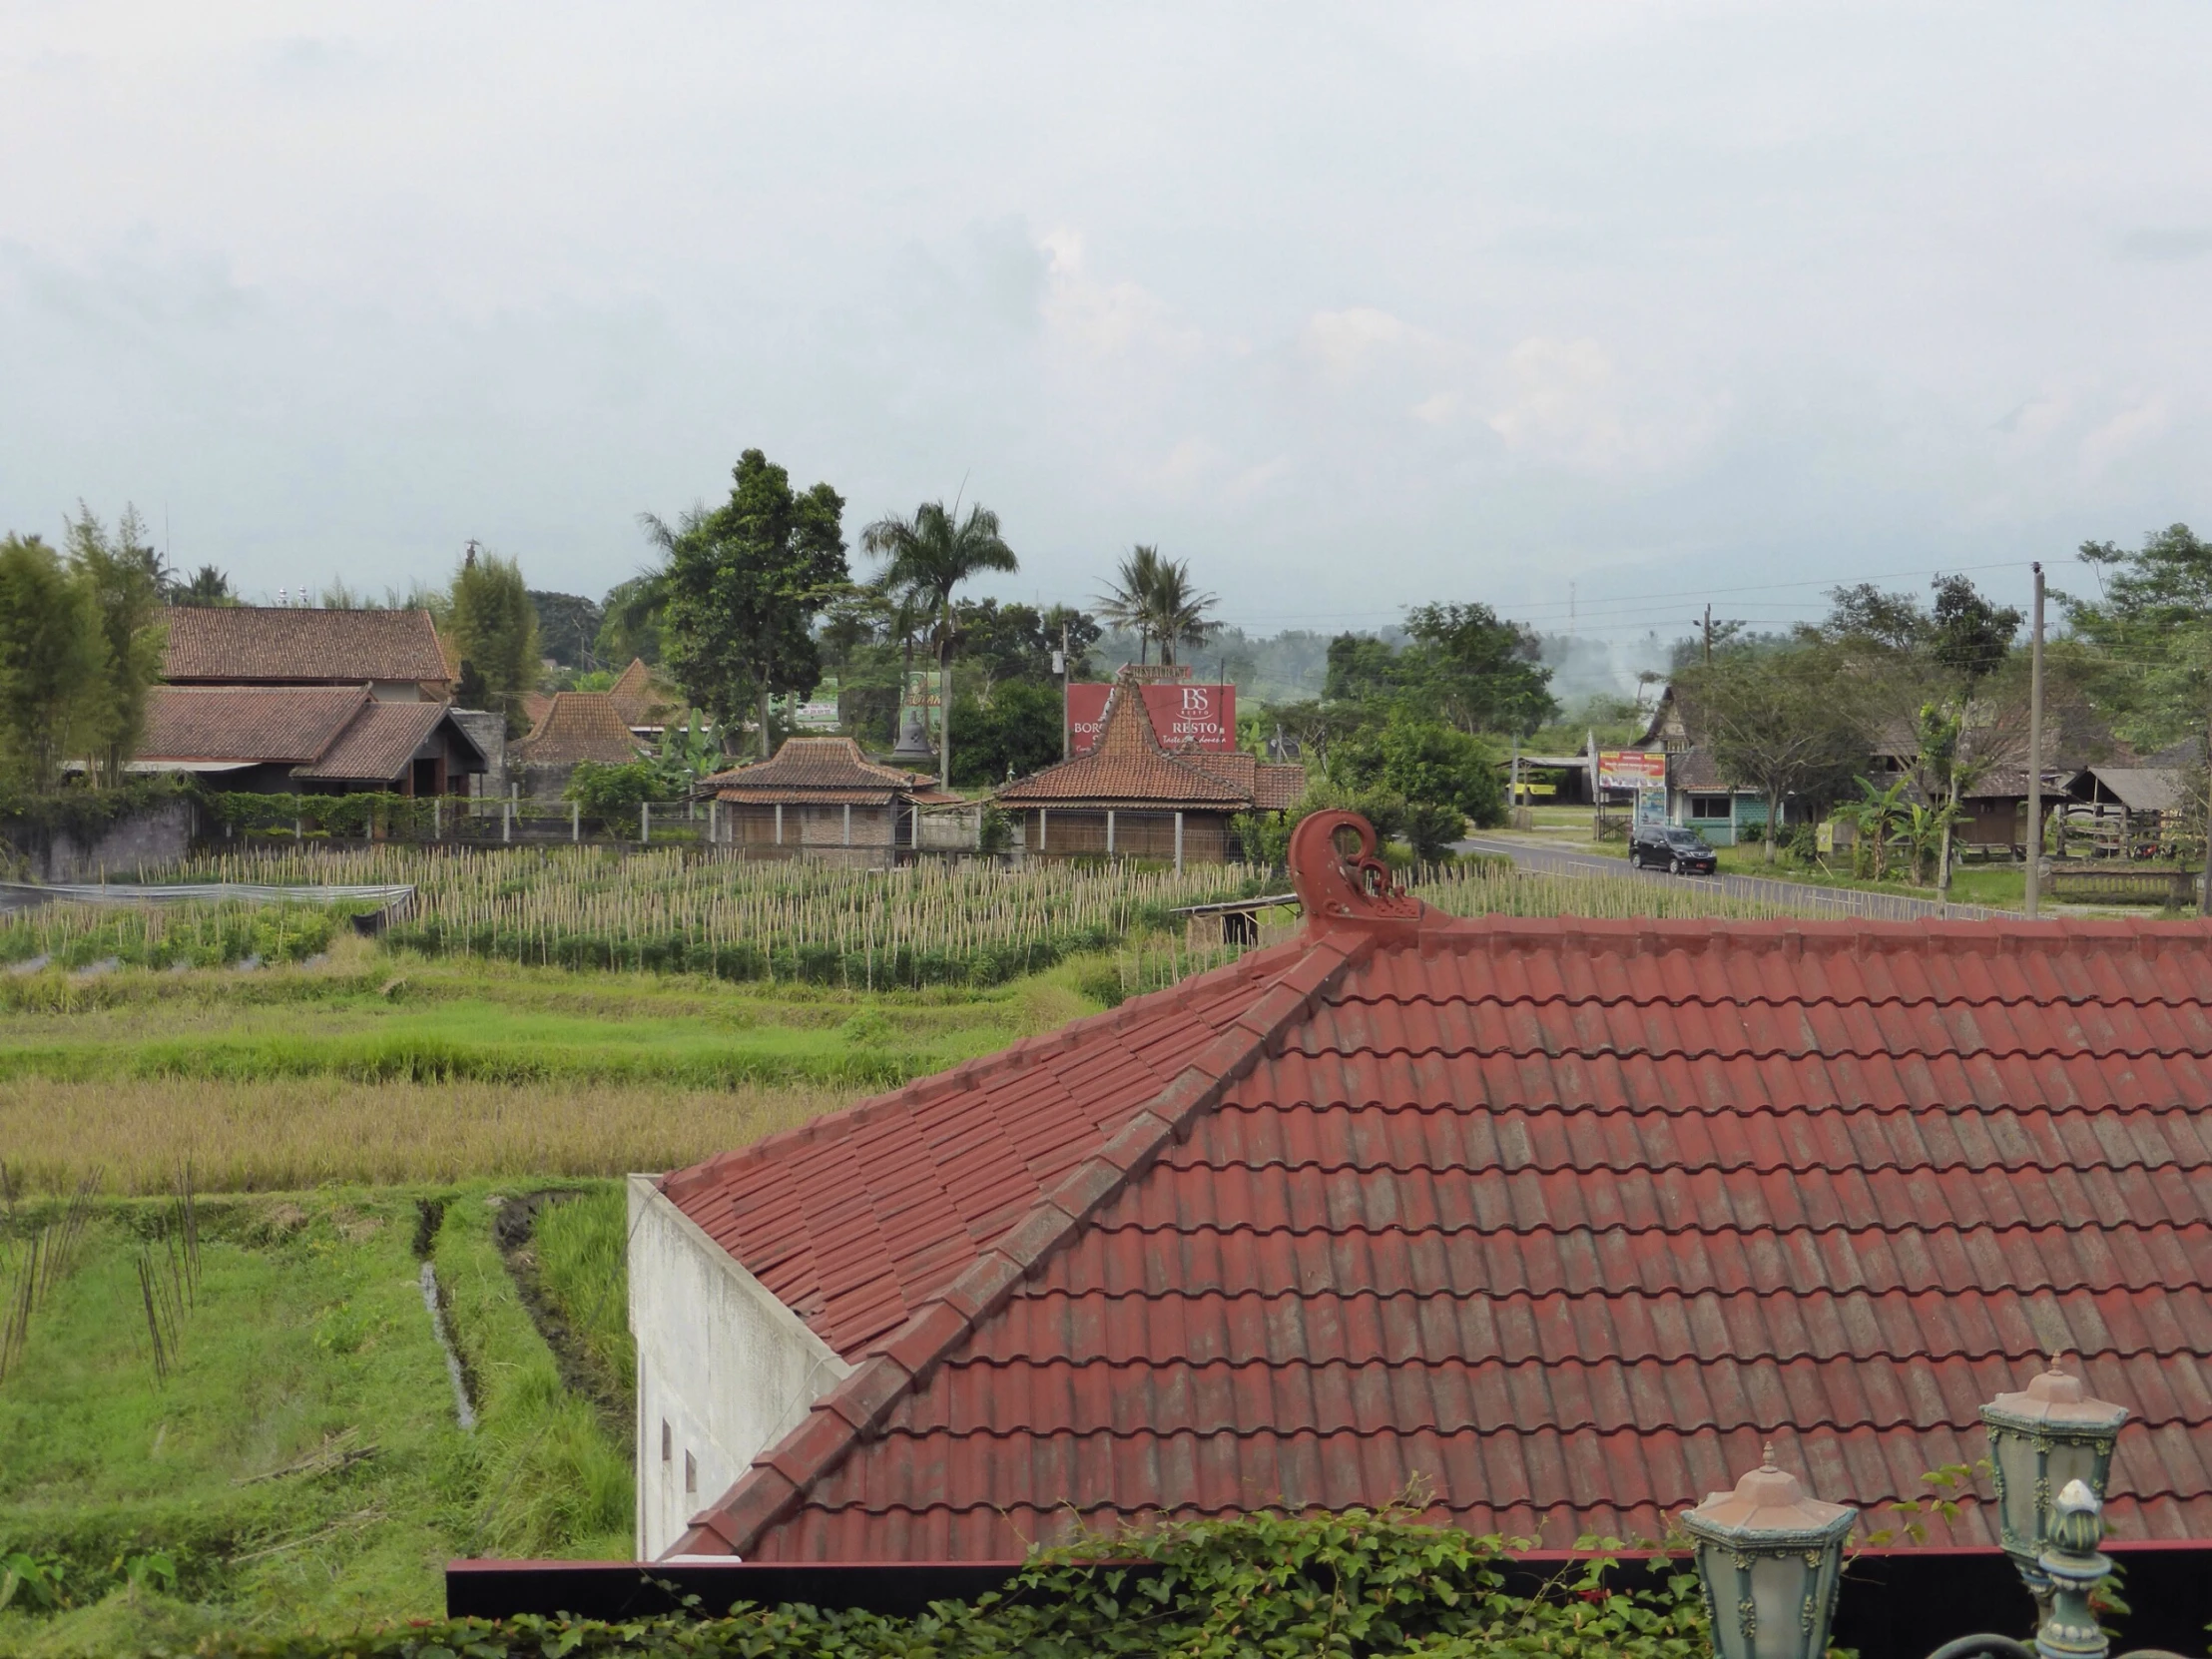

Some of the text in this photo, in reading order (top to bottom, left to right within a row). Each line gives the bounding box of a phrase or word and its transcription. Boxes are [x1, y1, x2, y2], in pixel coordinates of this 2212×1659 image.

[1133, 667, 1186, 678] RESTAURANT
[1181, 688, 1209, 710] BS
[1172, 722, 1217, 734] RESTO
